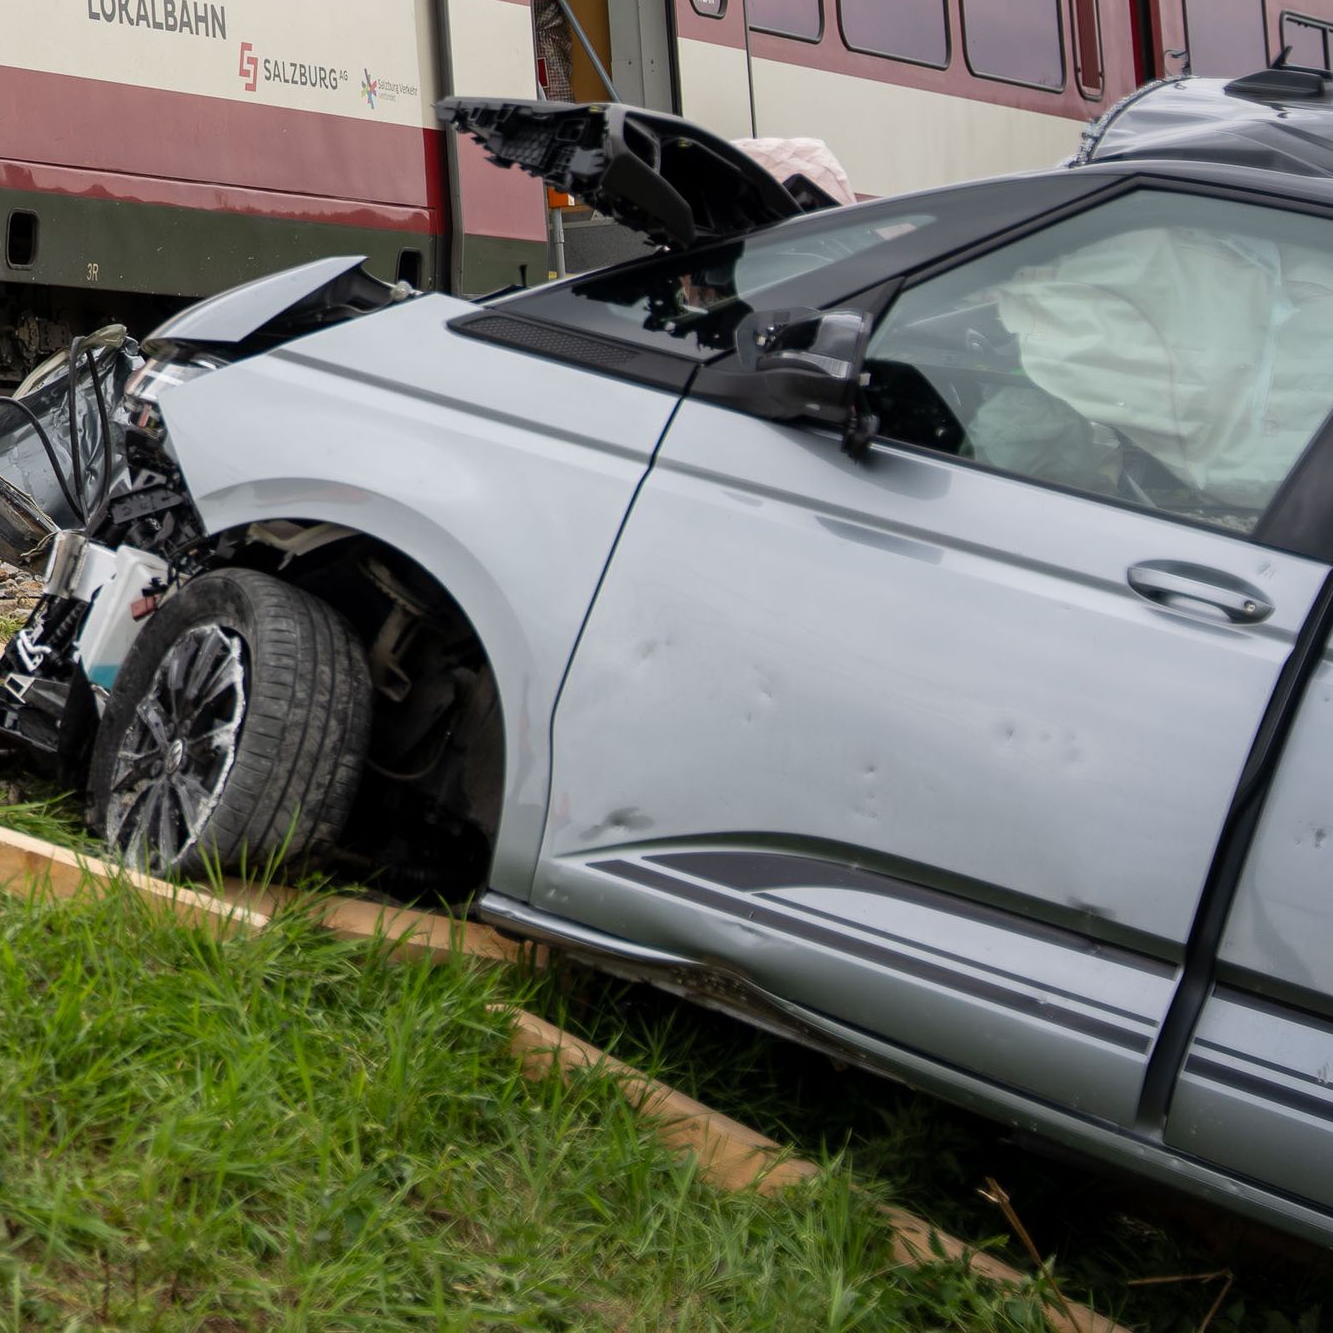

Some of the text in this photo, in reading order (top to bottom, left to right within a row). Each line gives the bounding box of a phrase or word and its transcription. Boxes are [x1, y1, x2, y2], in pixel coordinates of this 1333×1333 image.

[263, 58, 348, 90] SALZBURG AG
[377, 78, 399, 94] Salzburg
[86, 262, 99, 282] 3R
